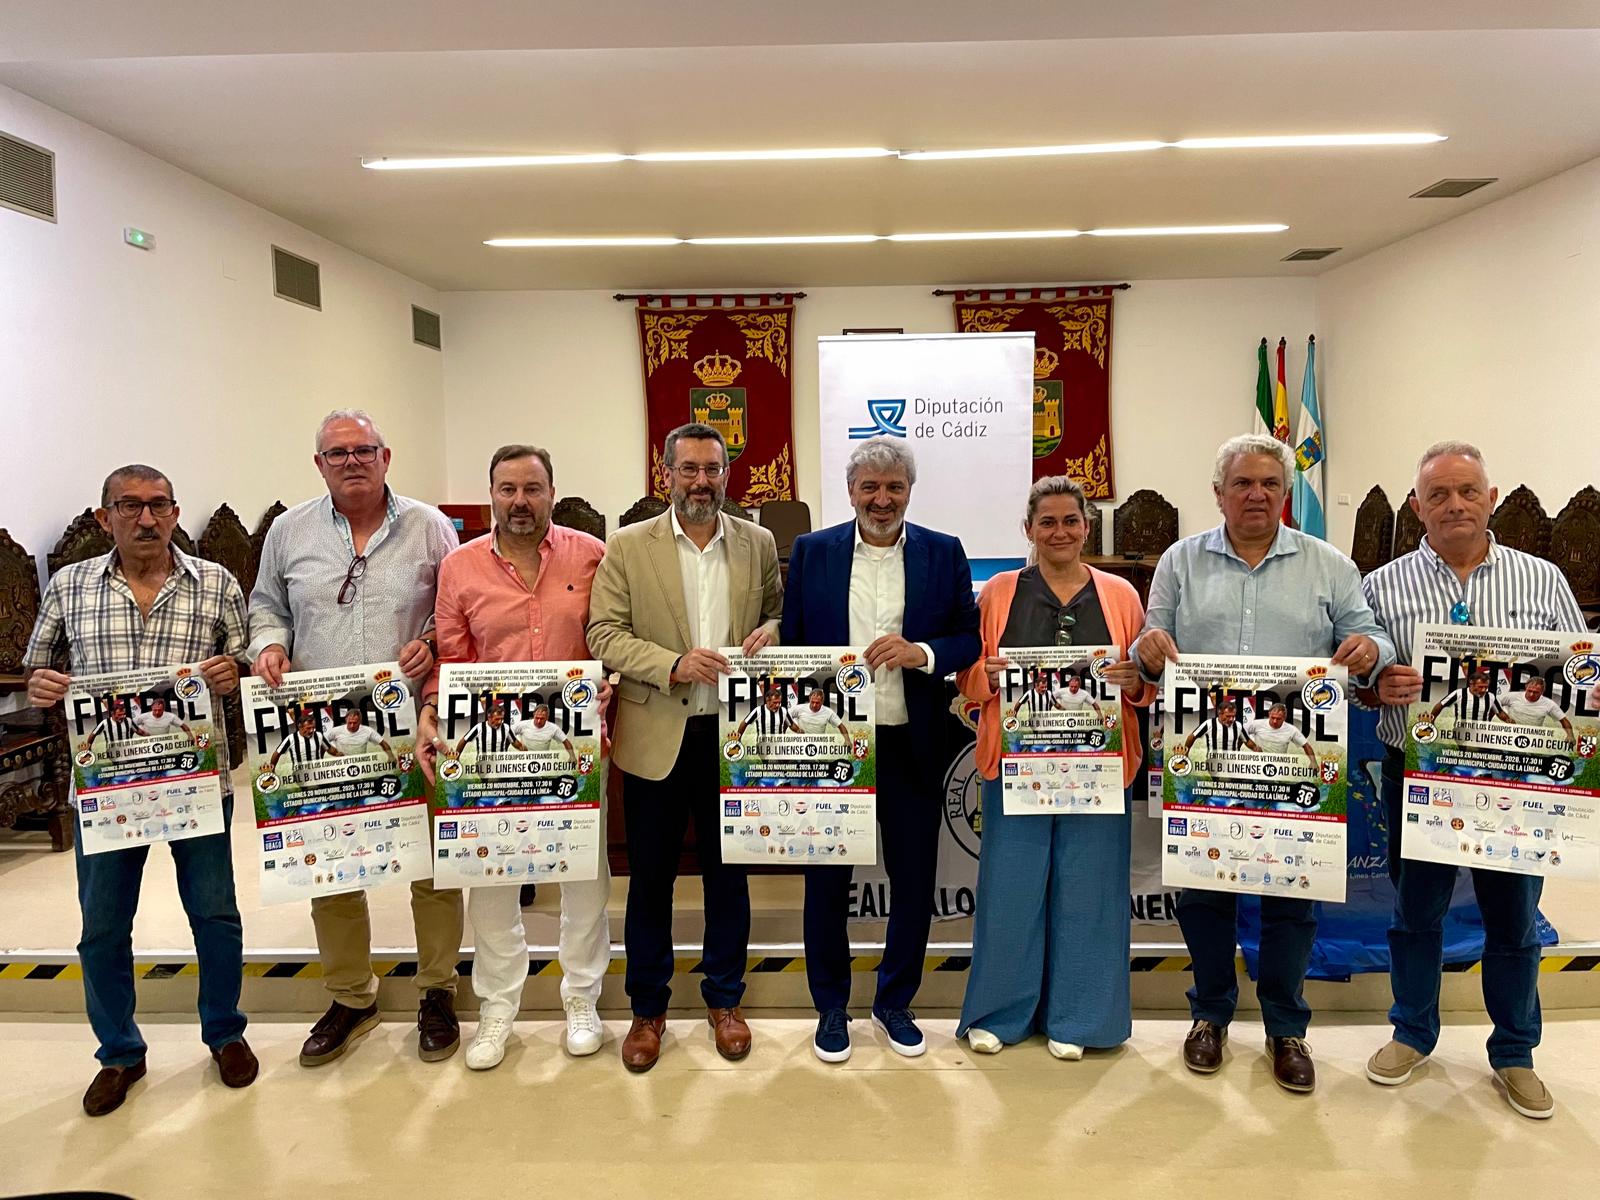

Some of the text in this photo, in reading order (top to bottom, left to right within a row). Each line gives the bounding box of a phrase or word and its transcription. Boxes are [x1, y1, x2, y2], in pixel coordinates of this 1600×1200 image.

[915, 397, 1003, 417] Diputación
[915, 421, 988, 438] de Cádiz
[1440, 729, 1462, 740] REAL
[1475, 732, 1512, 745] LINENSE
[1517, 737, 1527, 747] VS
[1530, 738, 1543, 748] AD
[1545, 739, 1574, 751] CEUTA
[747, 746, 763, 754] REAL
[775, 746, 803, 754] LINENSE
[807, 746, 815, 754] VS
[818, 746, 827, 754] AD
[829, 746, 851, 754] CEUTA
[179, 756, 193, 769] 3€
[465, 764, 483, 773] REAL
[496, 763, 526, 772] LINENSE
[530, 763, 538, 771] VS
[541, 762, 551, 770] AD
[553, 761, 575, 770] CEUTA
[1194, 761, 1214, 771] REAL
[1227, 763, 1261, 774] LINENSE
[1265, 765, 1274, 775] VS
[1278, 766, 1289, 775] AD
[1291, 766, 1318, 777] CEUTA
[282, 773, 301, 784] REAL
[313, 767, 345, 780] LINENSE
[348, 766, 358, 775] VS
[360, 764, 371, 773] AD
[372, 760, 396, 771] CEUTA
[834, 766, 847, 780] 3€
[1548, 762, 1567, 779] 3€
[379, 781, 395, 796] 3€
[557, 782, 571, 796] 3€
[951, 777, 967, 819] REAL
[1296, 789, 1313, 805] 3€
[1522, 800, 1543, 809] FUEL
[363, 820, 381, 828] FUEL
[1273, 828, 1292, 836] FUEL
[848, 883, 890, 917] EAL
